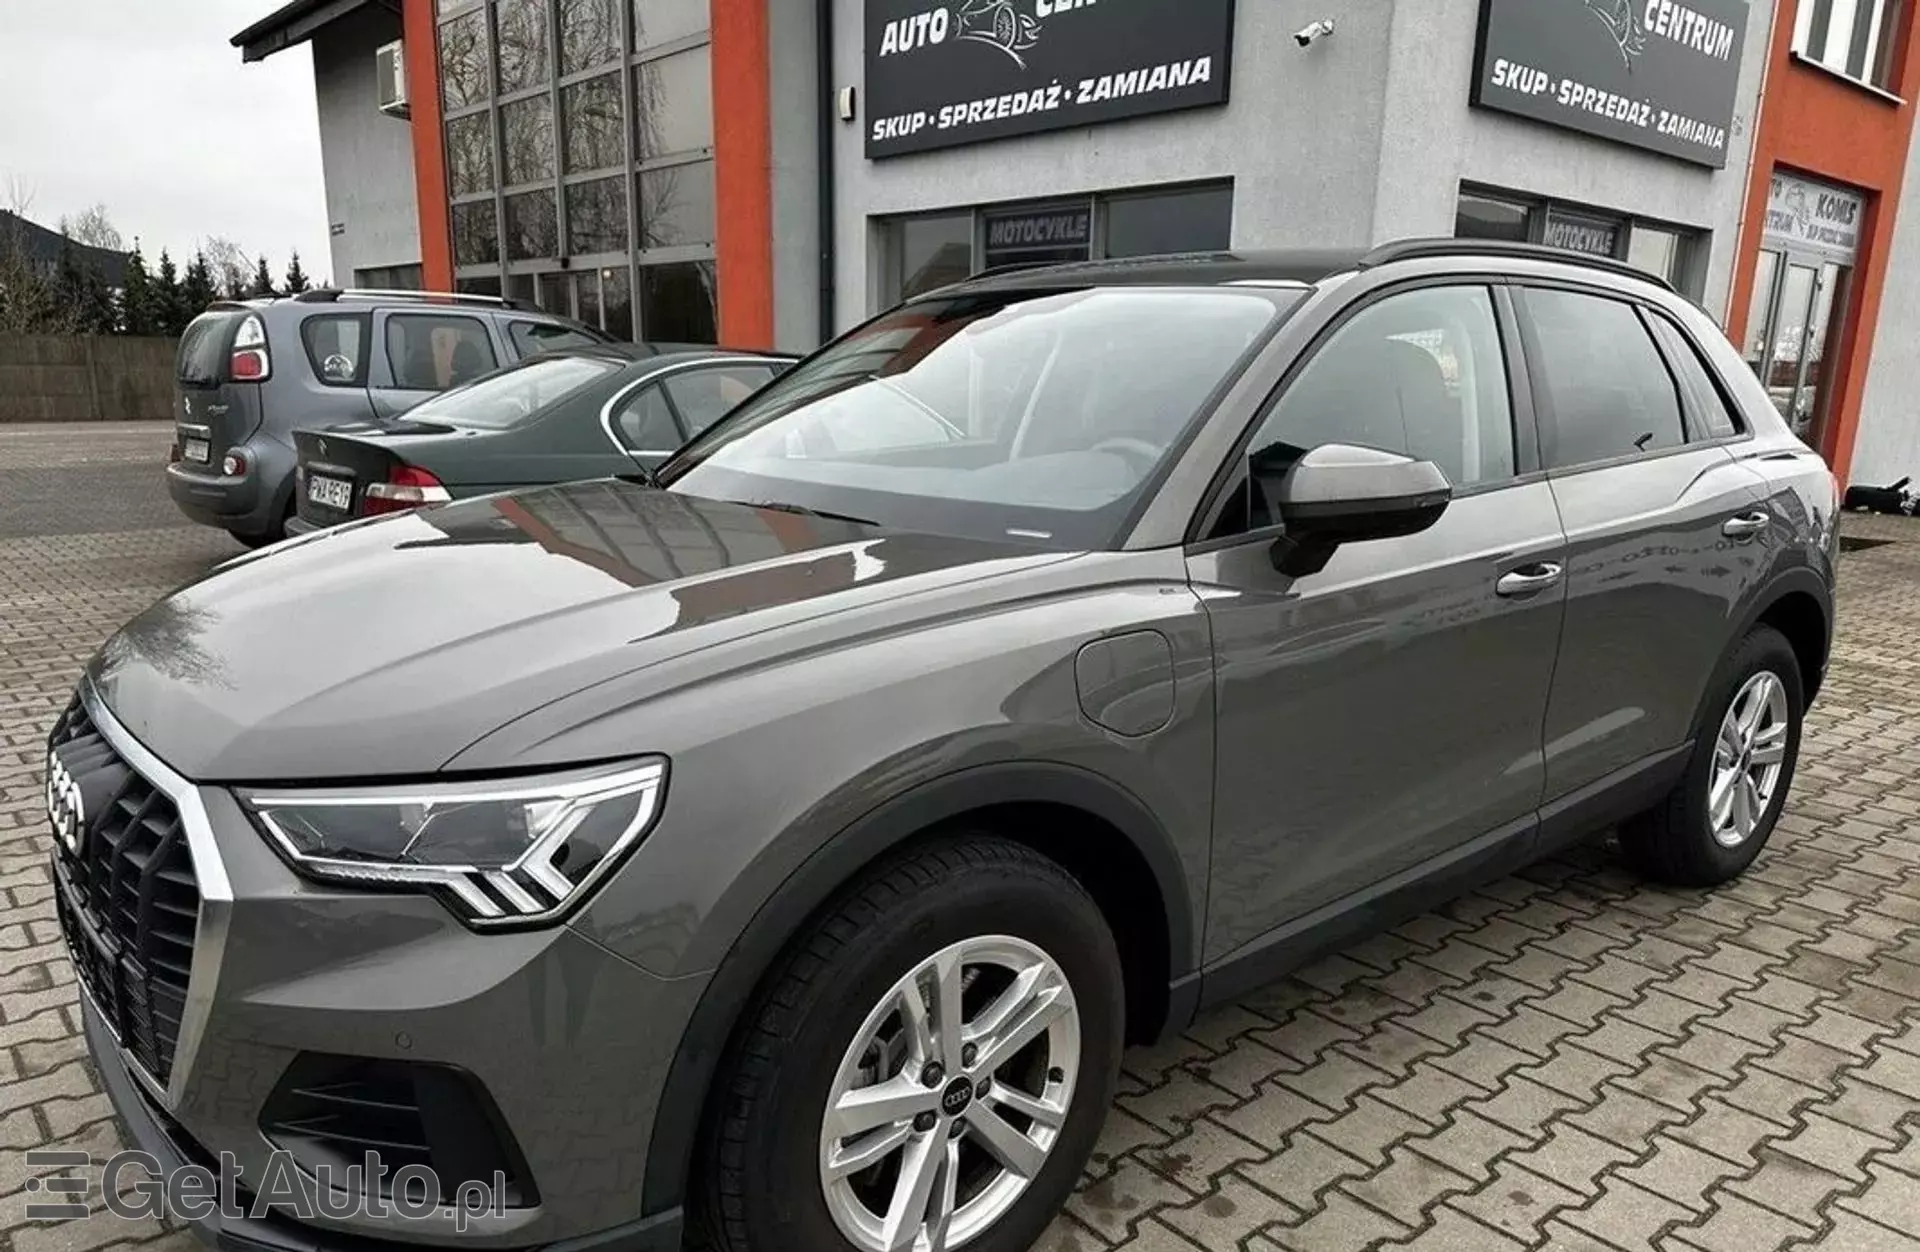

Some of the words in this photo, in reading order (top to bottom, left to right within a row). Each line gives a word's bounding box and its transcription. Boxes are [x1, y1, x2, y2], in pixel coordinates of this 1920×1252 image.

[879, 7, 949, 57] AUTO
[1644, 0, 1734, 60] CENTRUM
[872, 116, 925, 141] SKUP
[938, 79, 1061, 130] SPRZEDAŻ
[1074, 56, 1212, 104] ZAMIANA
[1491, 58, 1549, 95] SKUP
[1557, 78, 1652, 128] SPRZEDAŻ
[1657, 110, 1726, 149] ZAMIANA
[989, 214, 1088, 244] MOTOCYKLE
[1815, 193, 1857, 225] KOMIS
[1543, 223, 1613, 254] MOTOCYKLE
